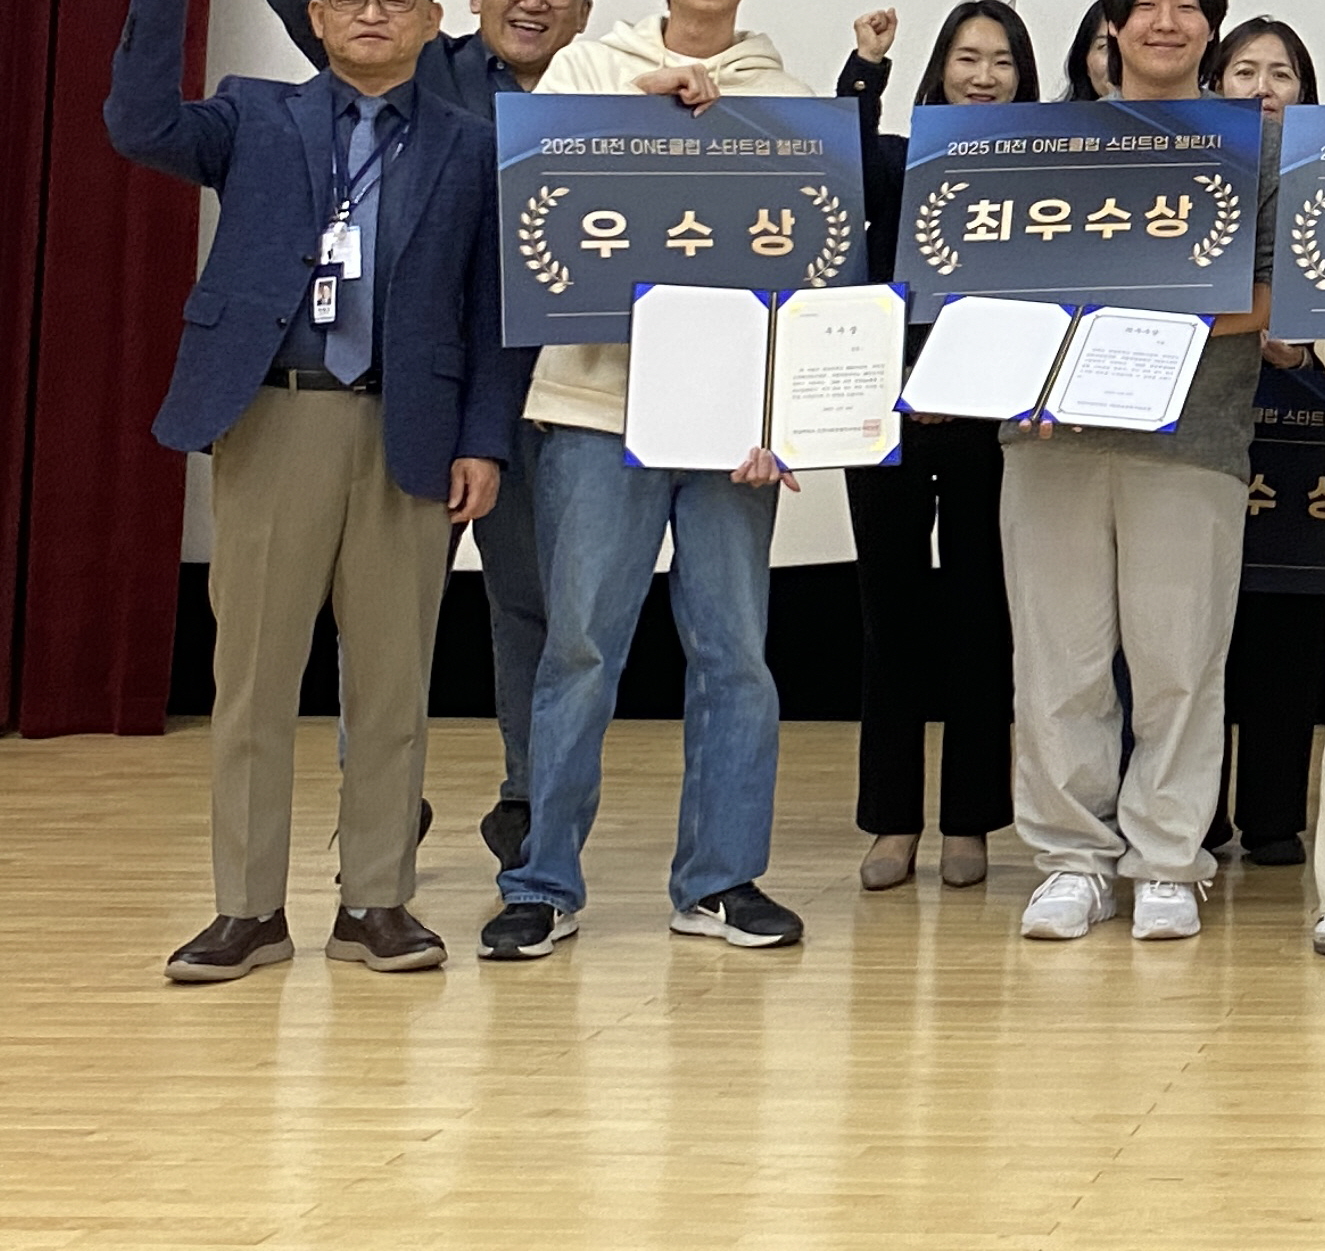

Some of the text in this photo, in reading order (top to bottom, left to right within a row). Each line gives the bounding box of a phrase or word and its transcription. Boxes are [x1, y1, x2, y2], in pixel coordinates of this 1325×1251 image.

[541, 138, 586, 154] 2025
[592, 138, 624, 155] 대전
[631, 139, 700, 155] ONE클럽
[706, 139, 770, 155] 스타트업
[948, 141, 989, 155] 2025
[995, 139, 1026, 153] 대전
[1033, 138, 1100, 153] ONE클럽
[1106, 136, 1169, 151] 스타트업
[962, 194, 1193, 242] 최우수상
